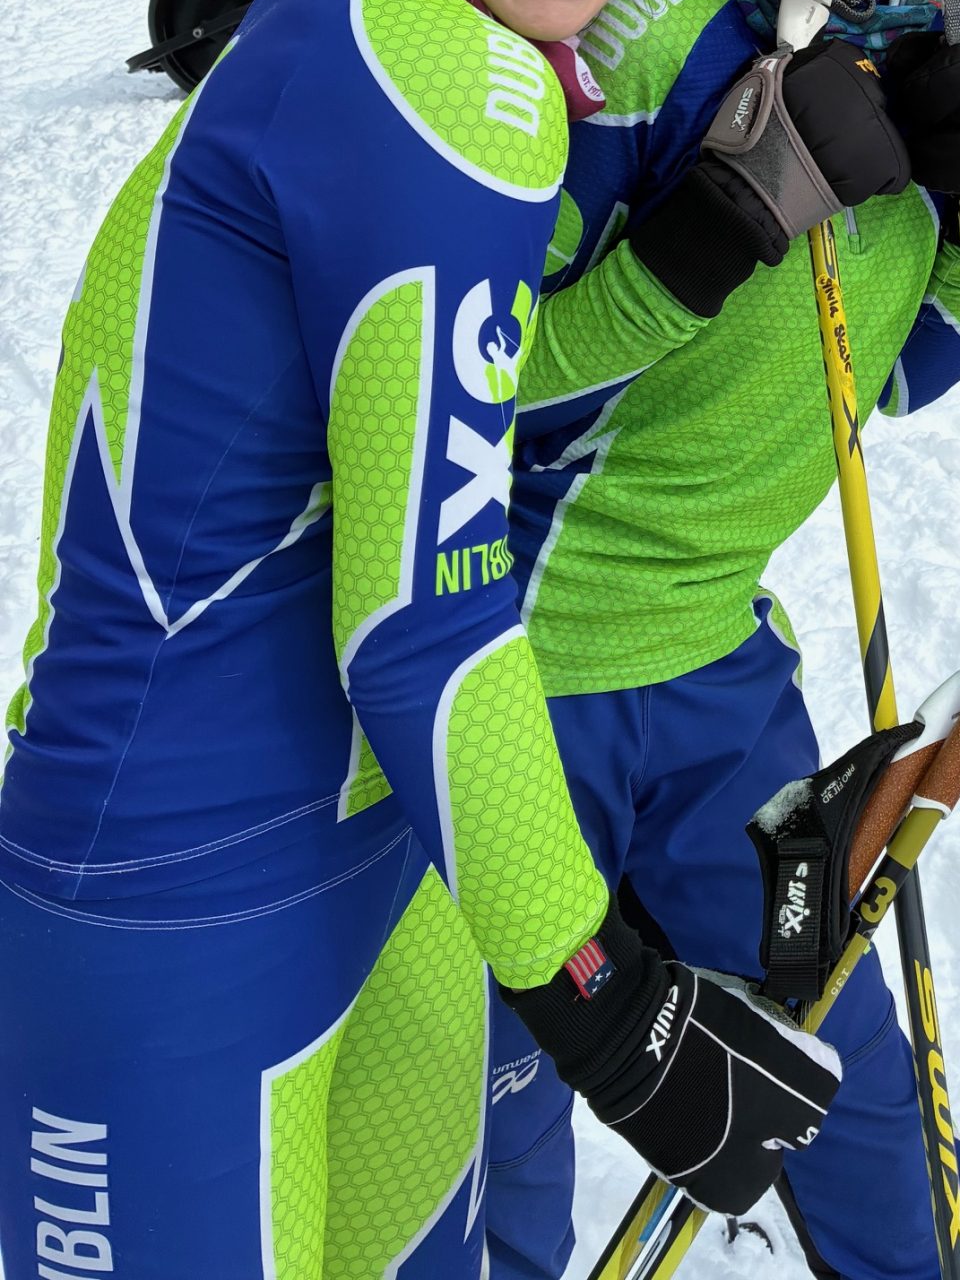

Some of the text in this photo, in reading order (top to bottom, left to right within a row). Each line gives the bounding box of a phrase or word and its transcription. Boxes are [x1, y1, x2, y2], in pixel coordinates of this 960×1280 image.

[483, 12, 546, 138] DUB
[435, 534, 514, 596] BLIN
[30, 1106, 114, 1280] BLIN
